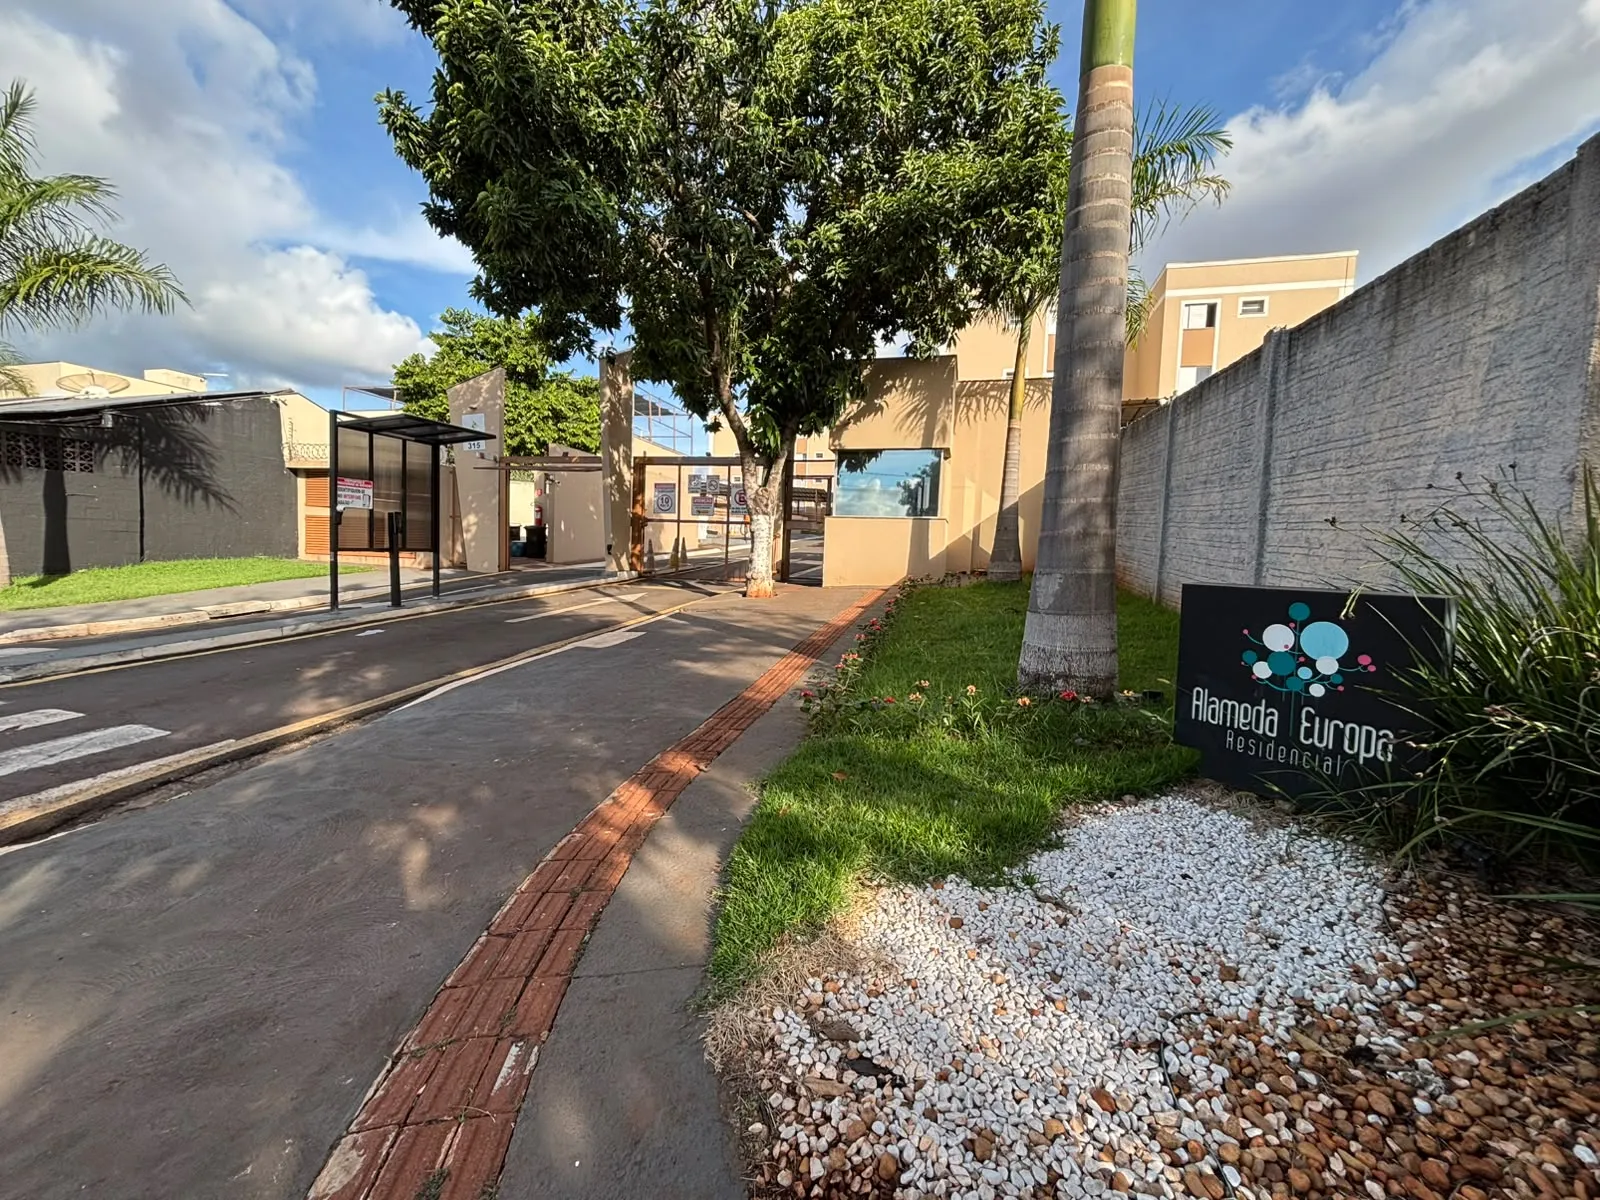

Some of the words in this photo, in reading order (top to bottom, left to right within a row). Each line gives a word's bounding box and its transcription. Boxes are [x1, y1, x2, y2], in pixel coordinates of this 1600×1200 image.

[660, 495, 670, 503] 10
[1191, 686, 1279, 738] Alameda
[1299, 706, 1394, 765] Europa
[1225, 729, 1341, 777] Residencial
